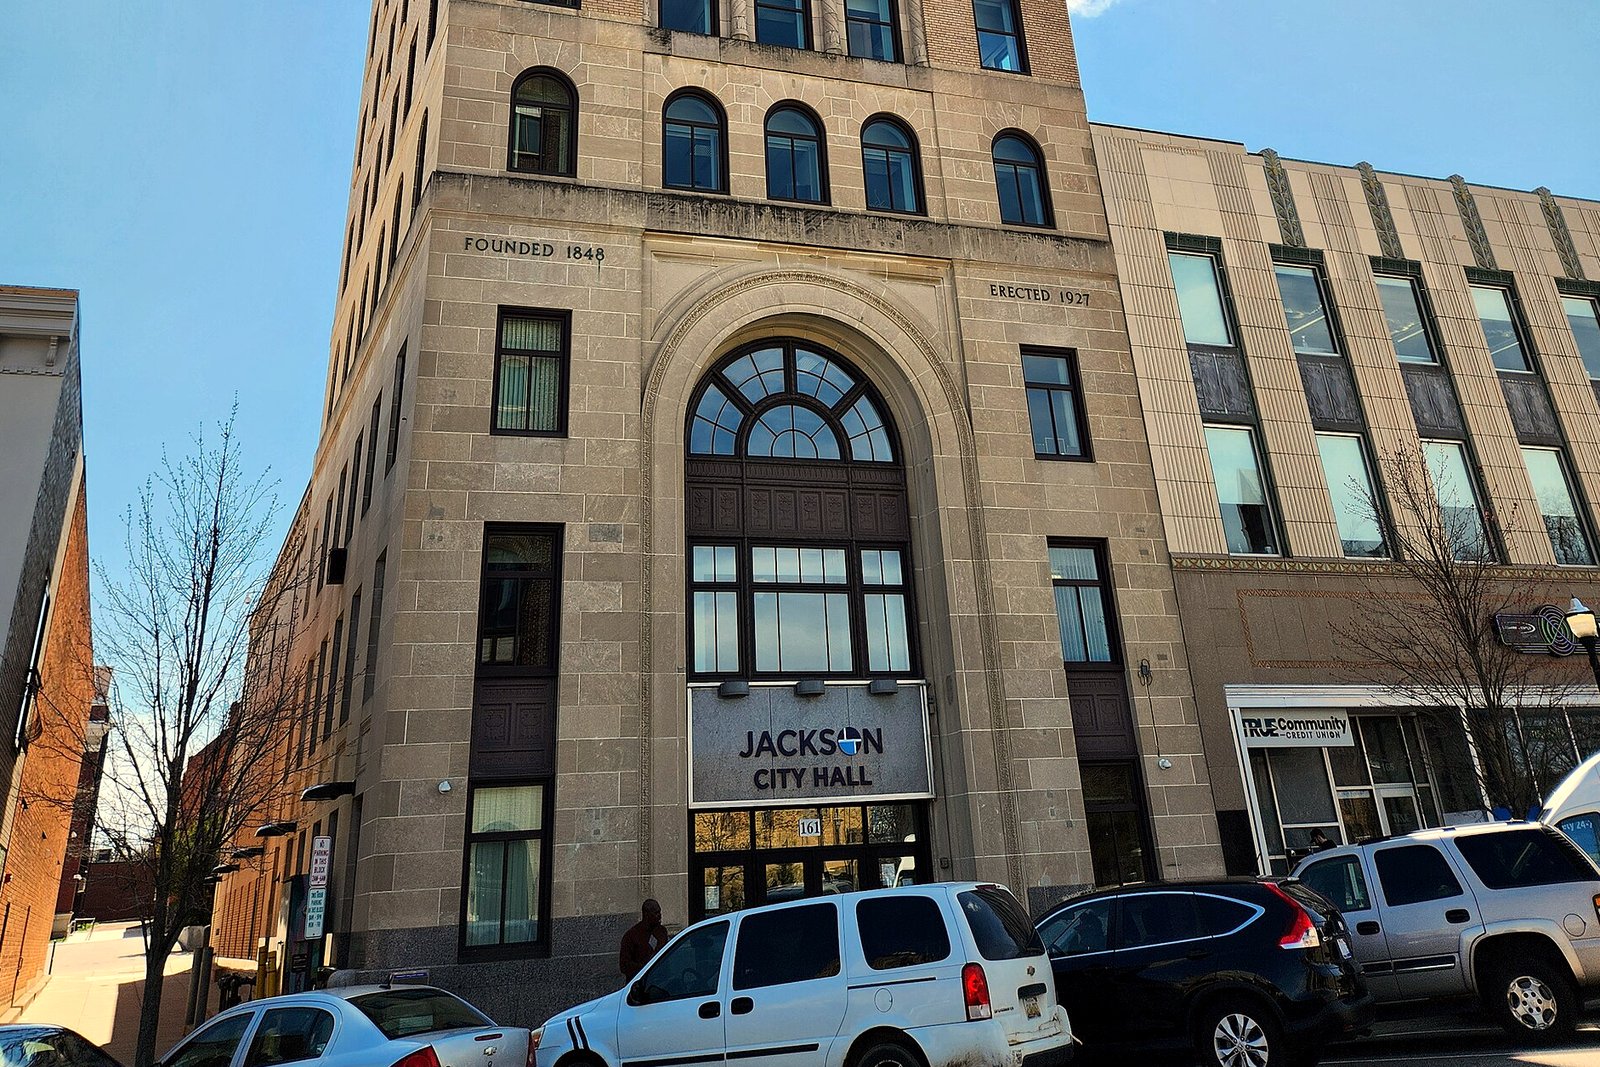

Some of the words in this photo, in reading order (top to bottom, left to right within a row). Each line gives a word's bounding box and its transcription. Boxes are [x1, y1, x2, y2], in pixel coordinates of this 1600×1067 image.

[464, 237, 554, 257] FOUNDED
[566, 245, 605, 261] 1848
[990, 284, 1051, 301] ERECTED
[1059, 291, 1090, 307] 1927
[1242, 718, 1279, 738] TRUE
[1277, 715, 1347, 734] Community
[1286, 731, 1313, 739] CREDIT
[1316, 731, 1341, 739] UNION
[738, 726, 884, 758] JACKSON
[753, 768, 807, 790] CITY
[813, 765, 873, 788] HALL
[800, 820, 820, 836] 161
